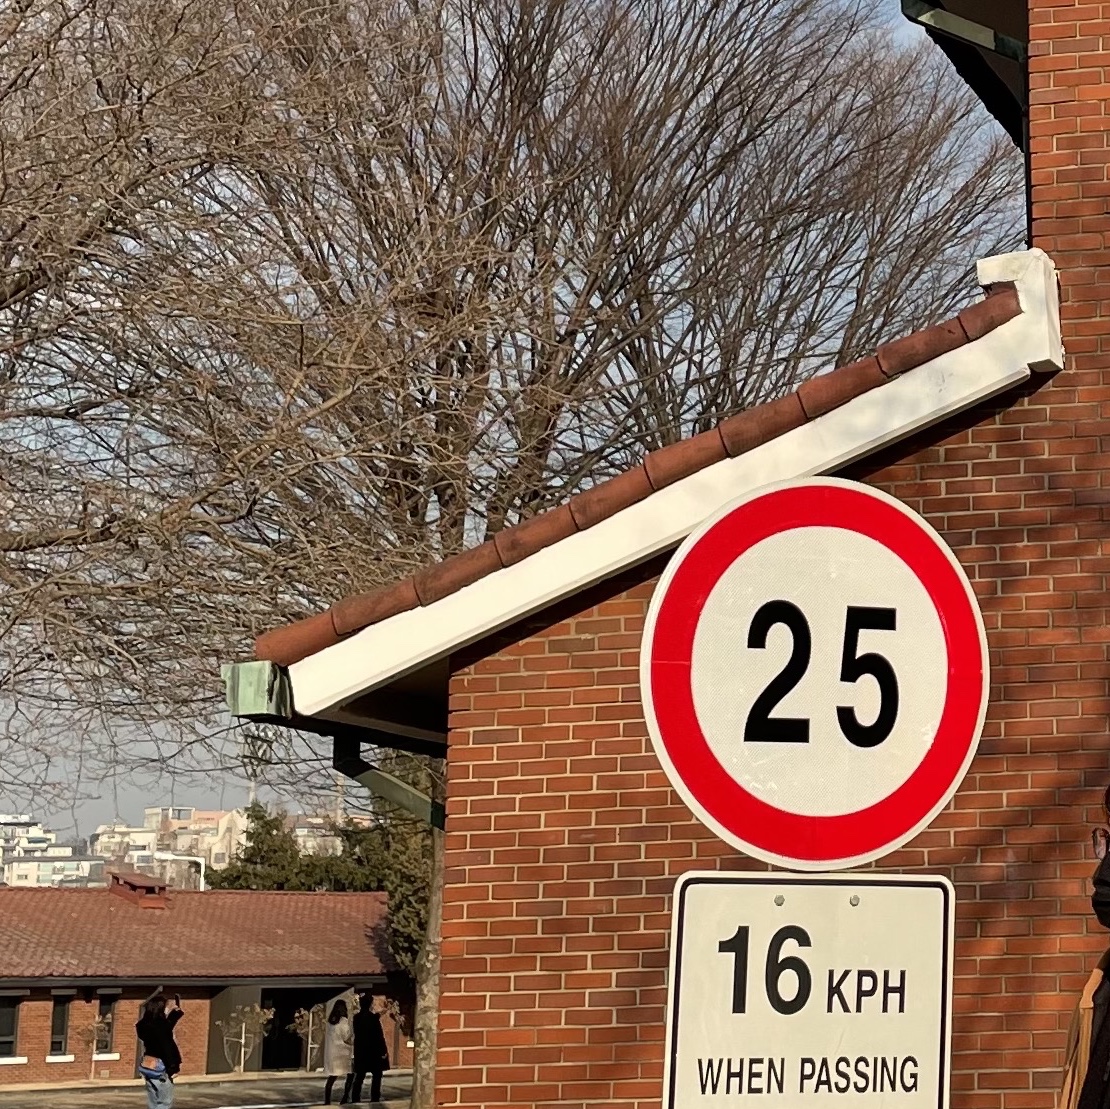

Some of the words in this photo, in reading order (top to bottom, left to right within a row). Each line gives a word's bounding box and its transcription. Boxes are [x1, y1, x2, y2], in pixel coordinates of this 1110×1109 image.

[743, 599, 900, 749] 25
[717, 924, 812, 1016] 16
[826, 969, 907, 1014] KPH
[697, 1057, 785, 1095] WHEN
[799, 1055, 919, 1094] PASSING
